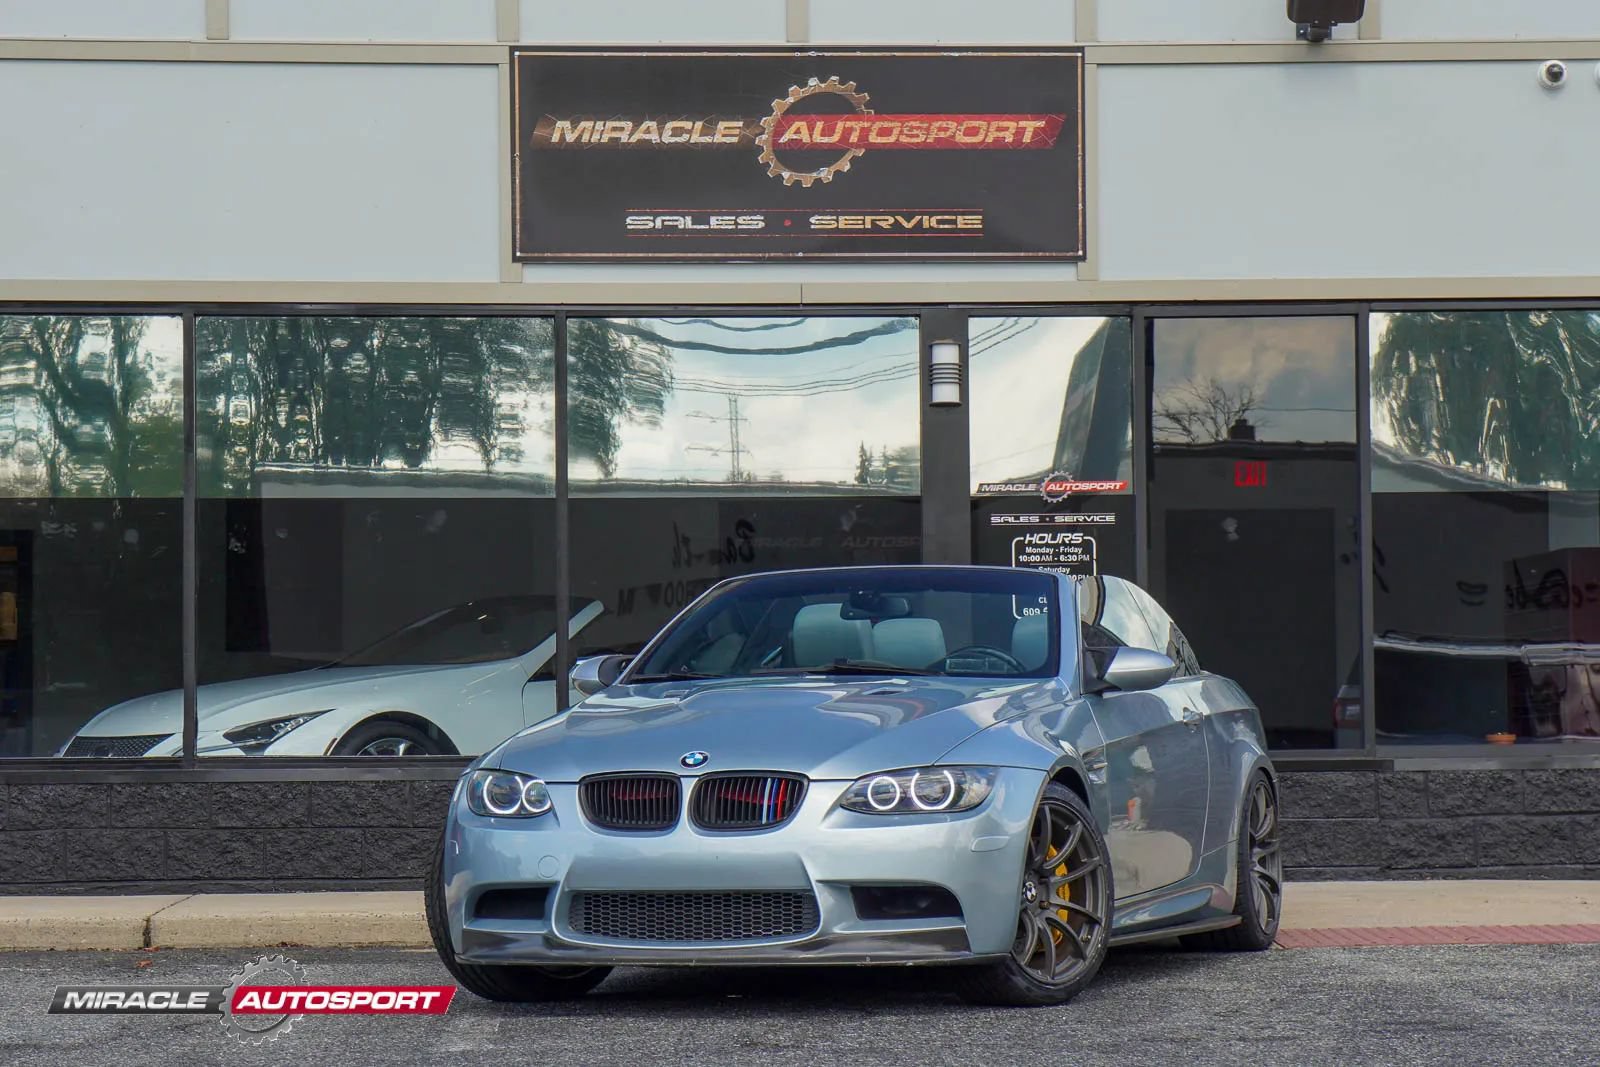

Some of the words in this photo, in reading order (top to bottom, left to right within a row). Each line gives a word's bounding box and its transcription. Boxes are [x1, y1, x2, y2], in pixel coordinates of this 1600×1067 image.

[550, 120, 743, 143] MIRACLE
[778, 119, 1047, 143] AUTOSPORT
[625, 215, 766, 230] SALES
[809, 215, 983, 230] SERVICE
[981, 483, 1037, 492] MIRACLE
[1046, 482, 1124, 491] AUTOSPORT
[990, 515, 1040, 523] SALES
[1054, 515, 1116, 523] SERVICE
[1024, 532, 1084, 544] HOURS
[1025, 546, 1054, 555] Monday
[1060, 546, 1083, 554] Friday
